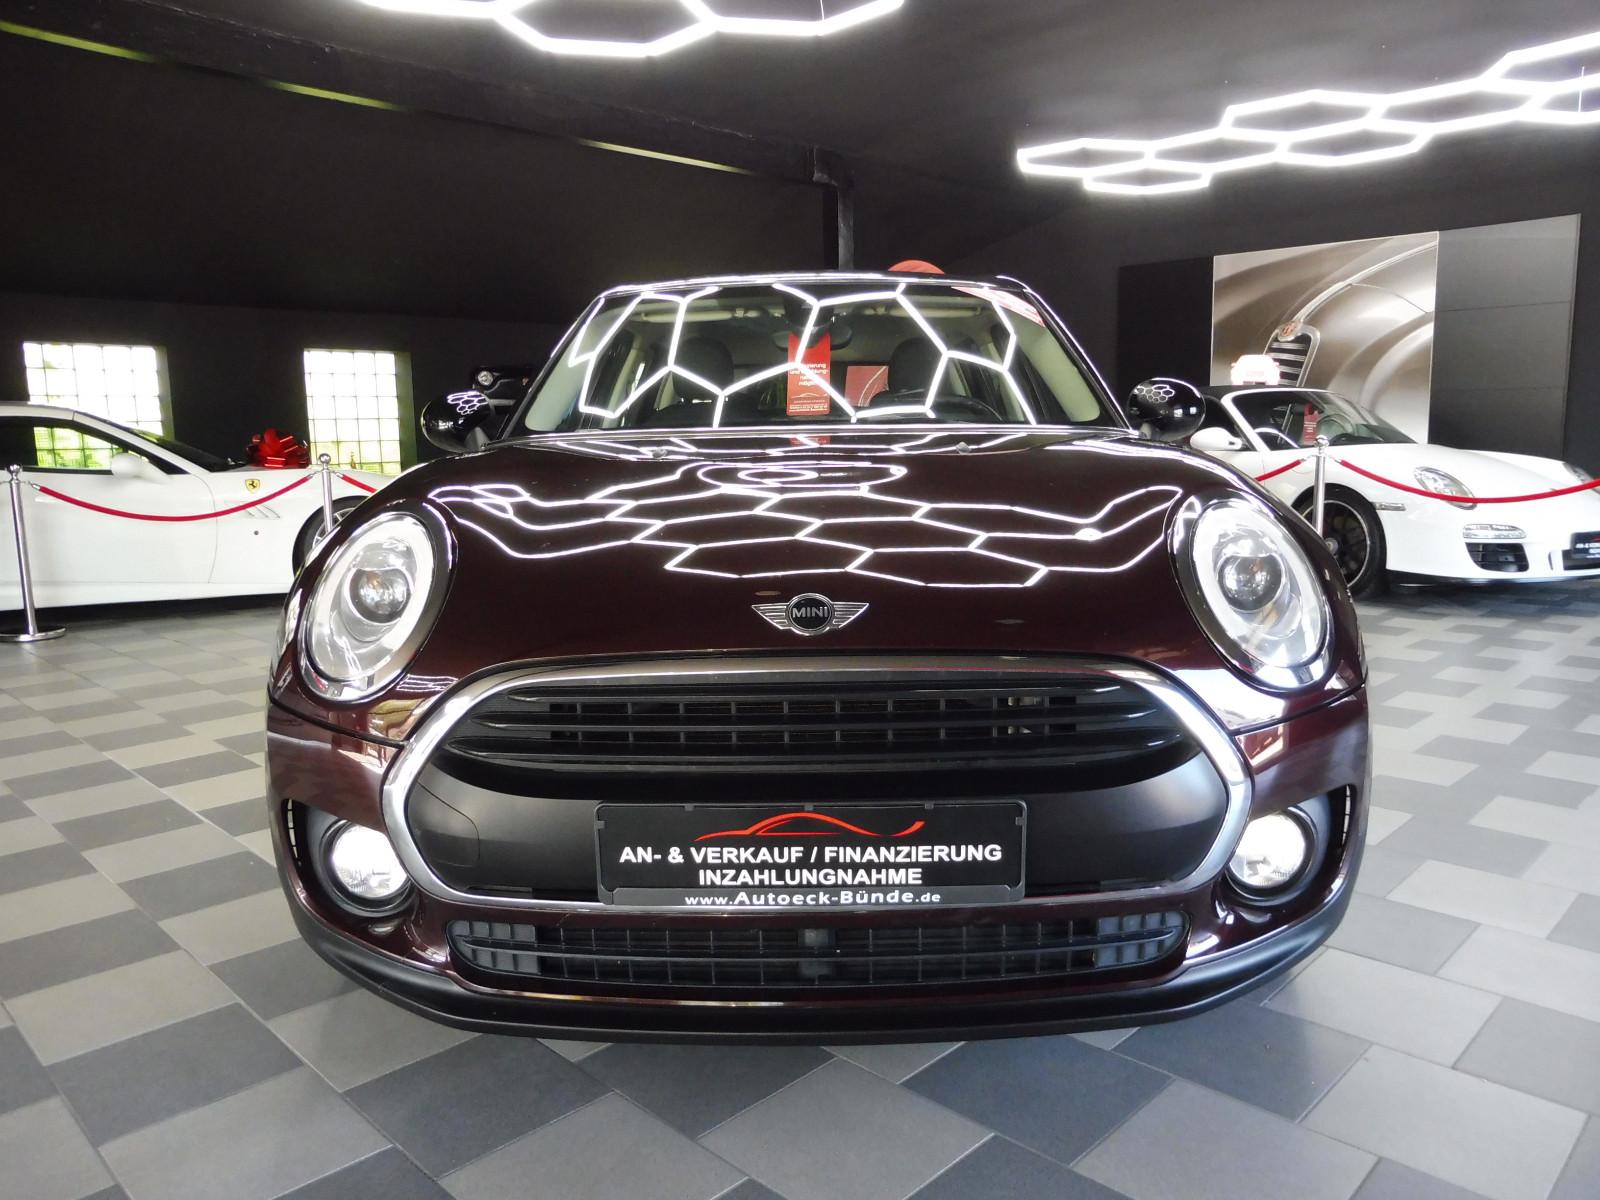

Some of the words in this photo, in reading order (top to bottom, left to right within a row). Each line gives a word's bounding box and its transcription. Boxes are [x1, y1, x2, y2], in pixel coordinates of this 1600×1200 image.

[792, 606, 828, 618] MINI
[619, 846, 662, 863] AN-
[667, 846, 685, 863] &
[690, 846, 804, 863] VERKAUF
[810, 846, 818, 863] /
[824, 844, 1002, 863] FINANZIERUNG
[698, 868, 923, 886] INZAHLUNGNAHME
[684, 889, 942, 906] www.Autoeck-Bünde.de
